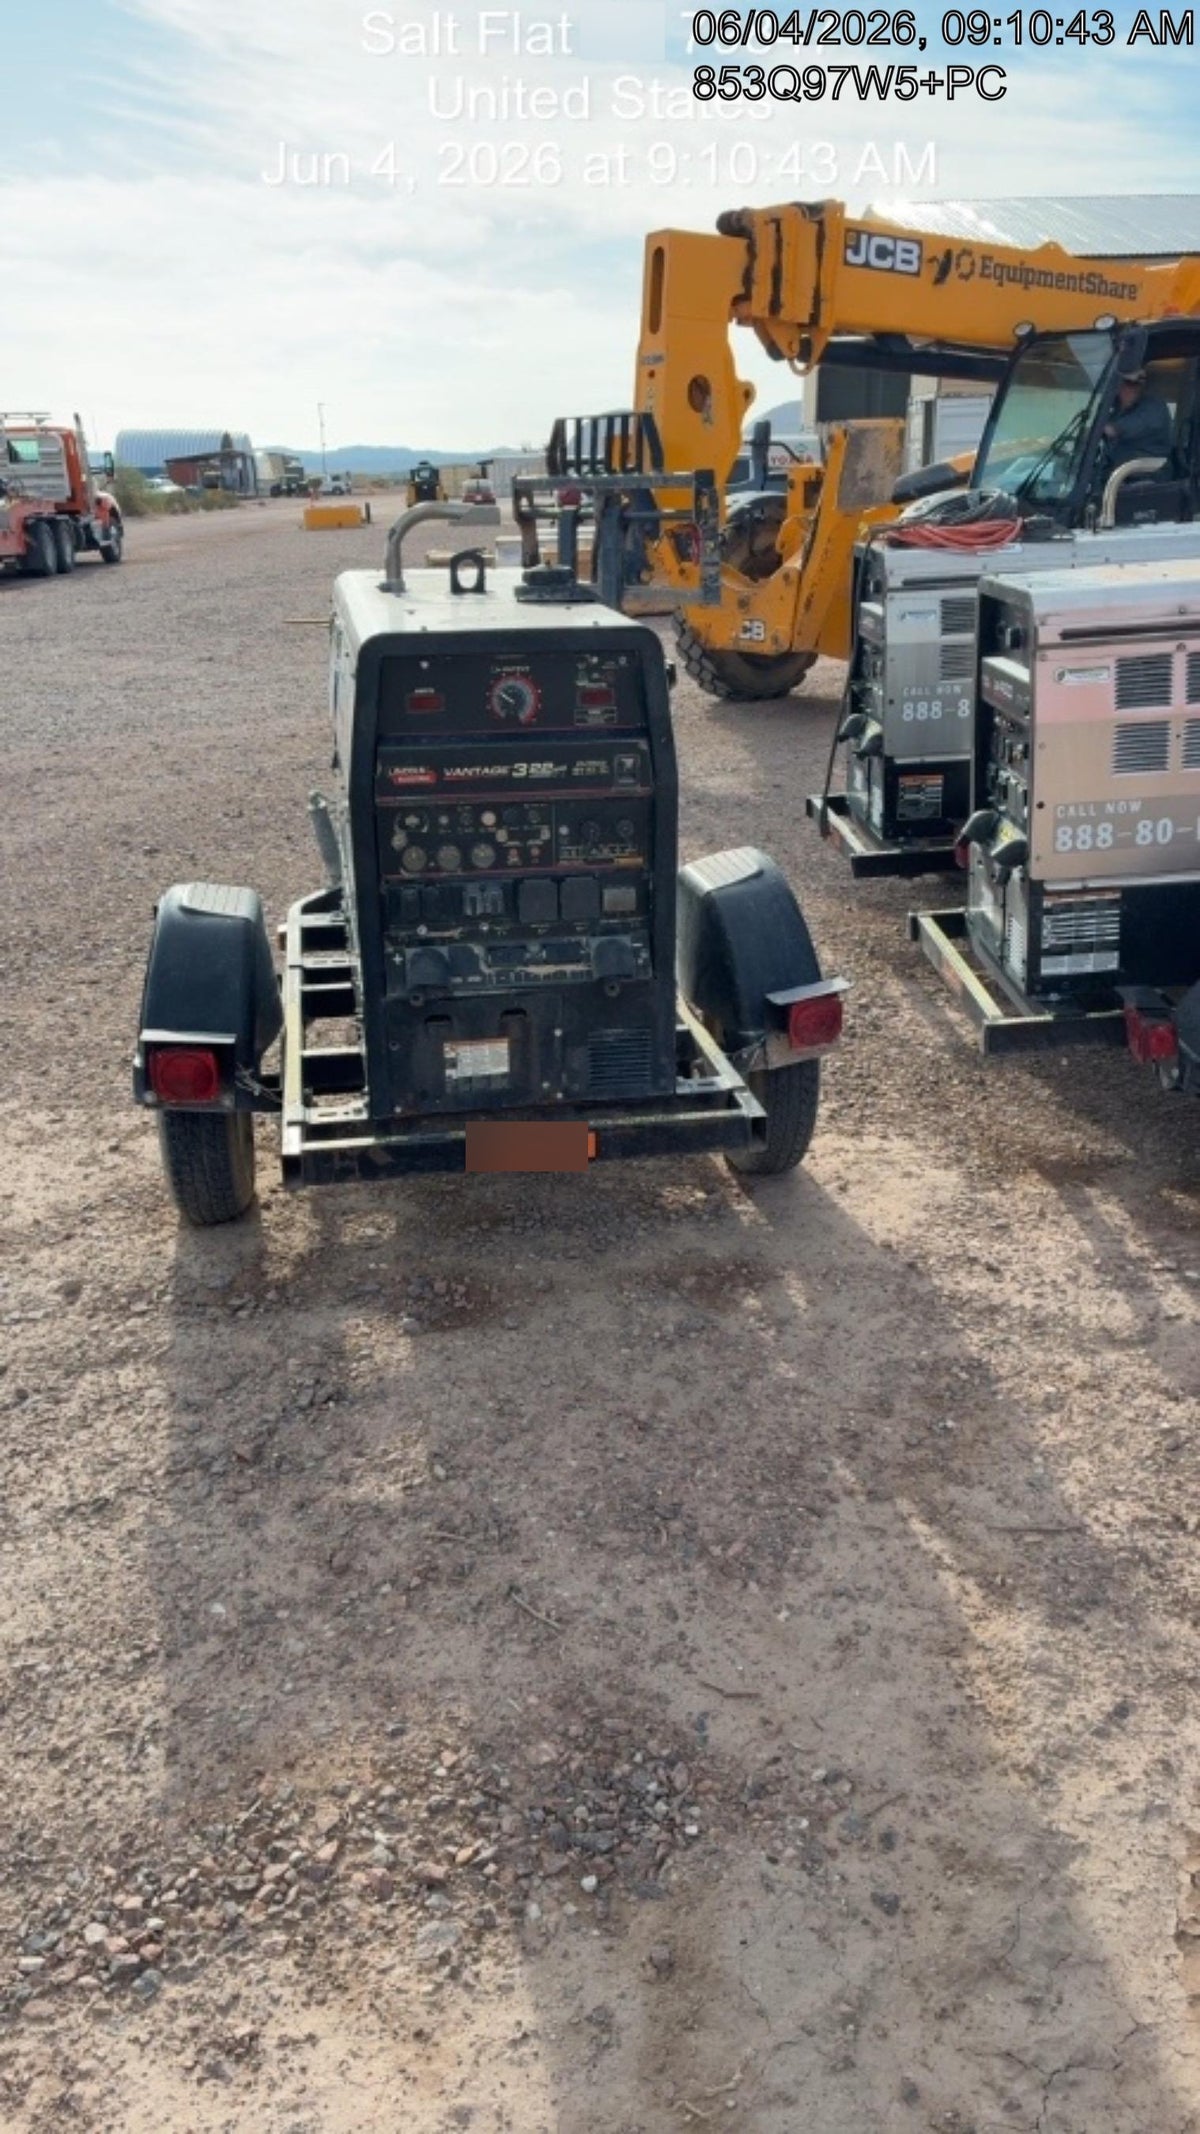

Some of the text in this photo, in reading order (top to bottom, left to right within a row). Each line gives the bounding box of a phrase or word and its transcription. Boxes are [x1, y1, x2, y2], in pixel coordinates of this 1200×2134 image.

[845, 233, 919, 272] JCB
[979, 255, 1138, 300] EquipmentShare
[443, 765, 511, 777] VANTAGE
[1057, 800, 1142, 818] CALL NOW
[1056, 816, 1200, 852] 888-80-
